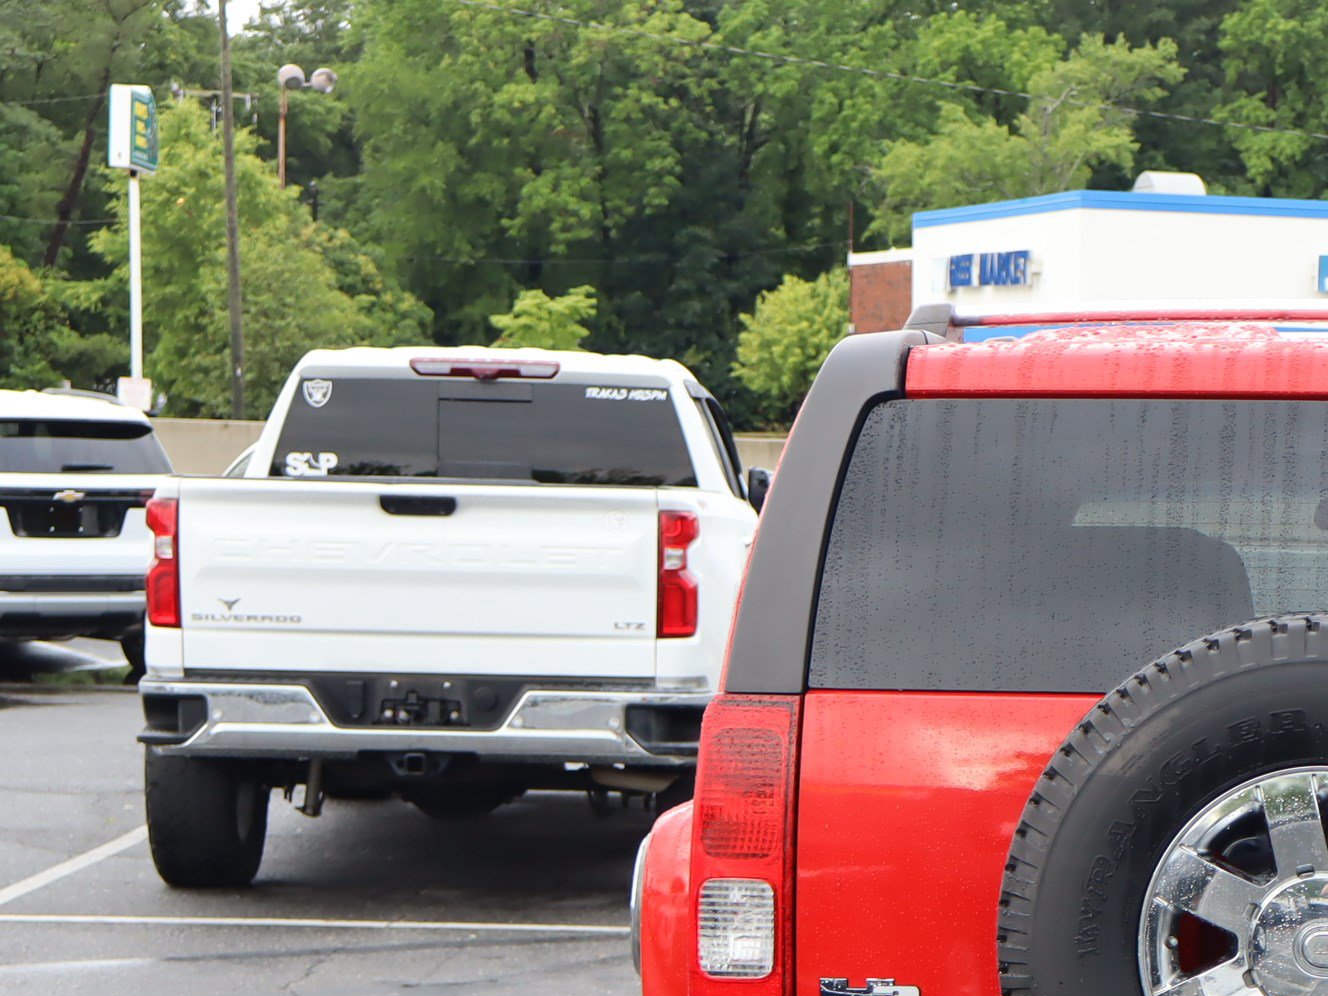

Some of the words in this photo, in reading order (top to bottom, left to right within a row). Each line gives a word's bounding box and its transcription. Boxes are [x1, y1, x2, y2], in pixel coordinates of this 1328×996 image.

[211, 537, 624, 570] CHEVROLET
[191, 613, 302, 624] SILVERADO
[613, 621, 647, 631] LTZ
